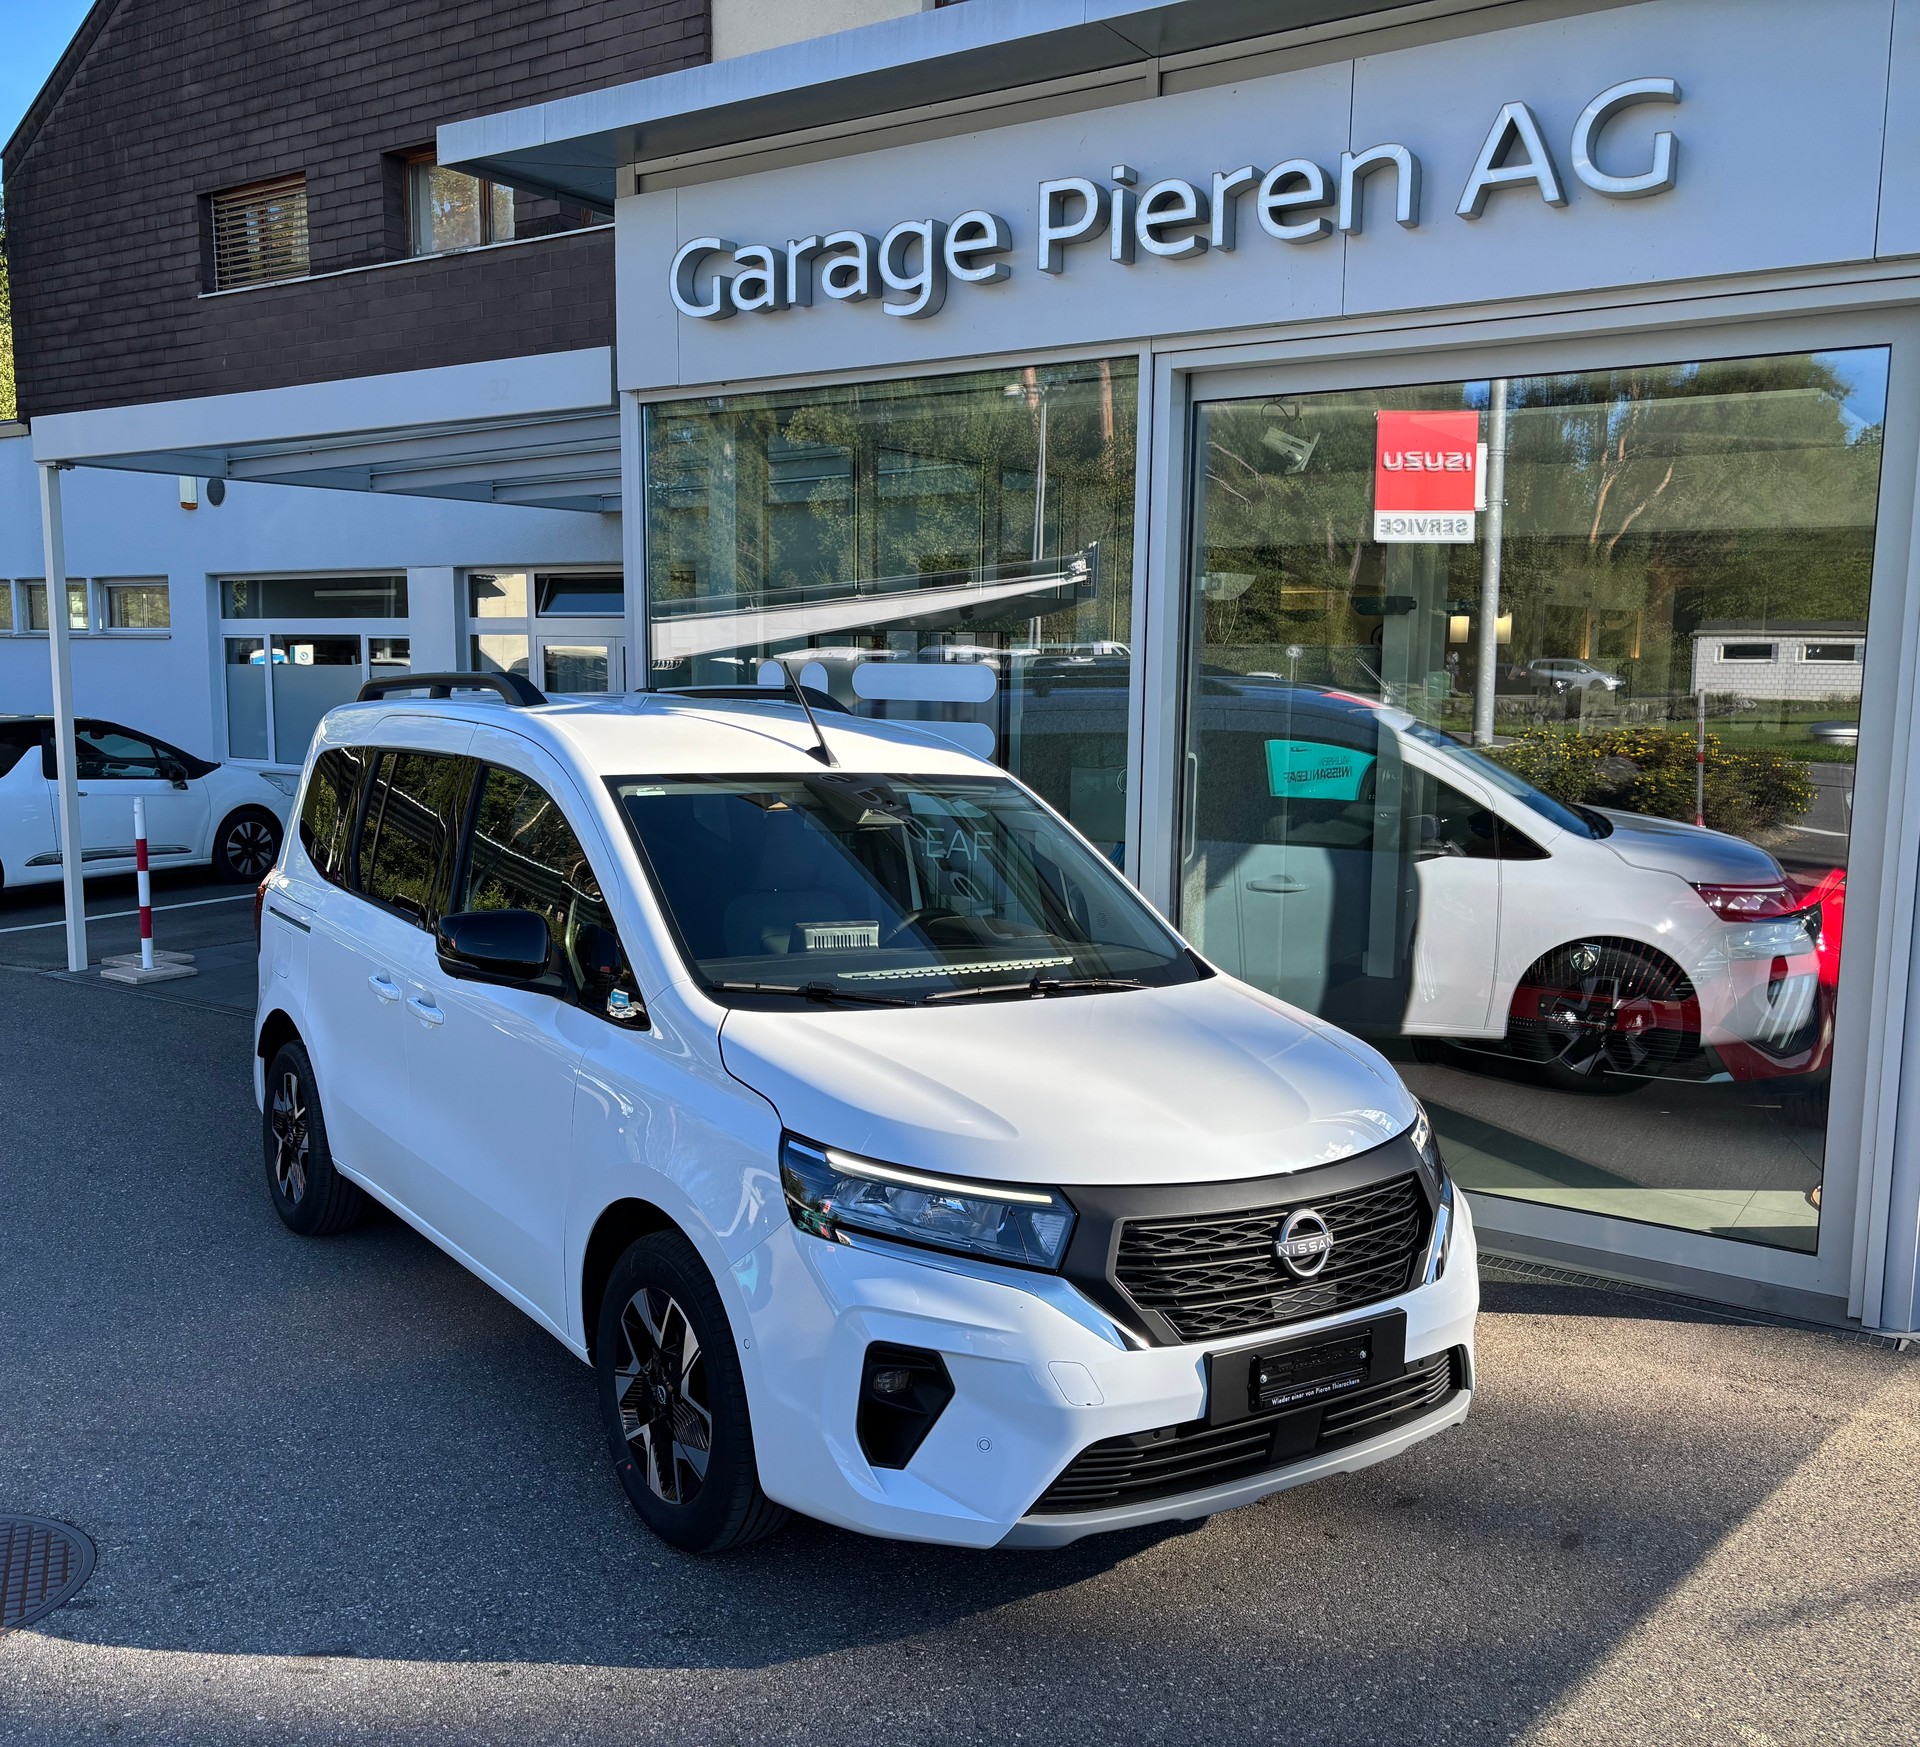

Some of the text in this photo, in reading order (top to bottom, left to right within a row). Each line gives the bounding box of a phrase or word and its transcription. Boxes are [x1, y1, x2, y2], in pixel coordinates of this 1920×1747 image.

[669, 77, 1682, 320] Garage Pieren AG
[921, 827, 993, 861] EAF
[1278, 1236, 1333, 1255] NISSAN
